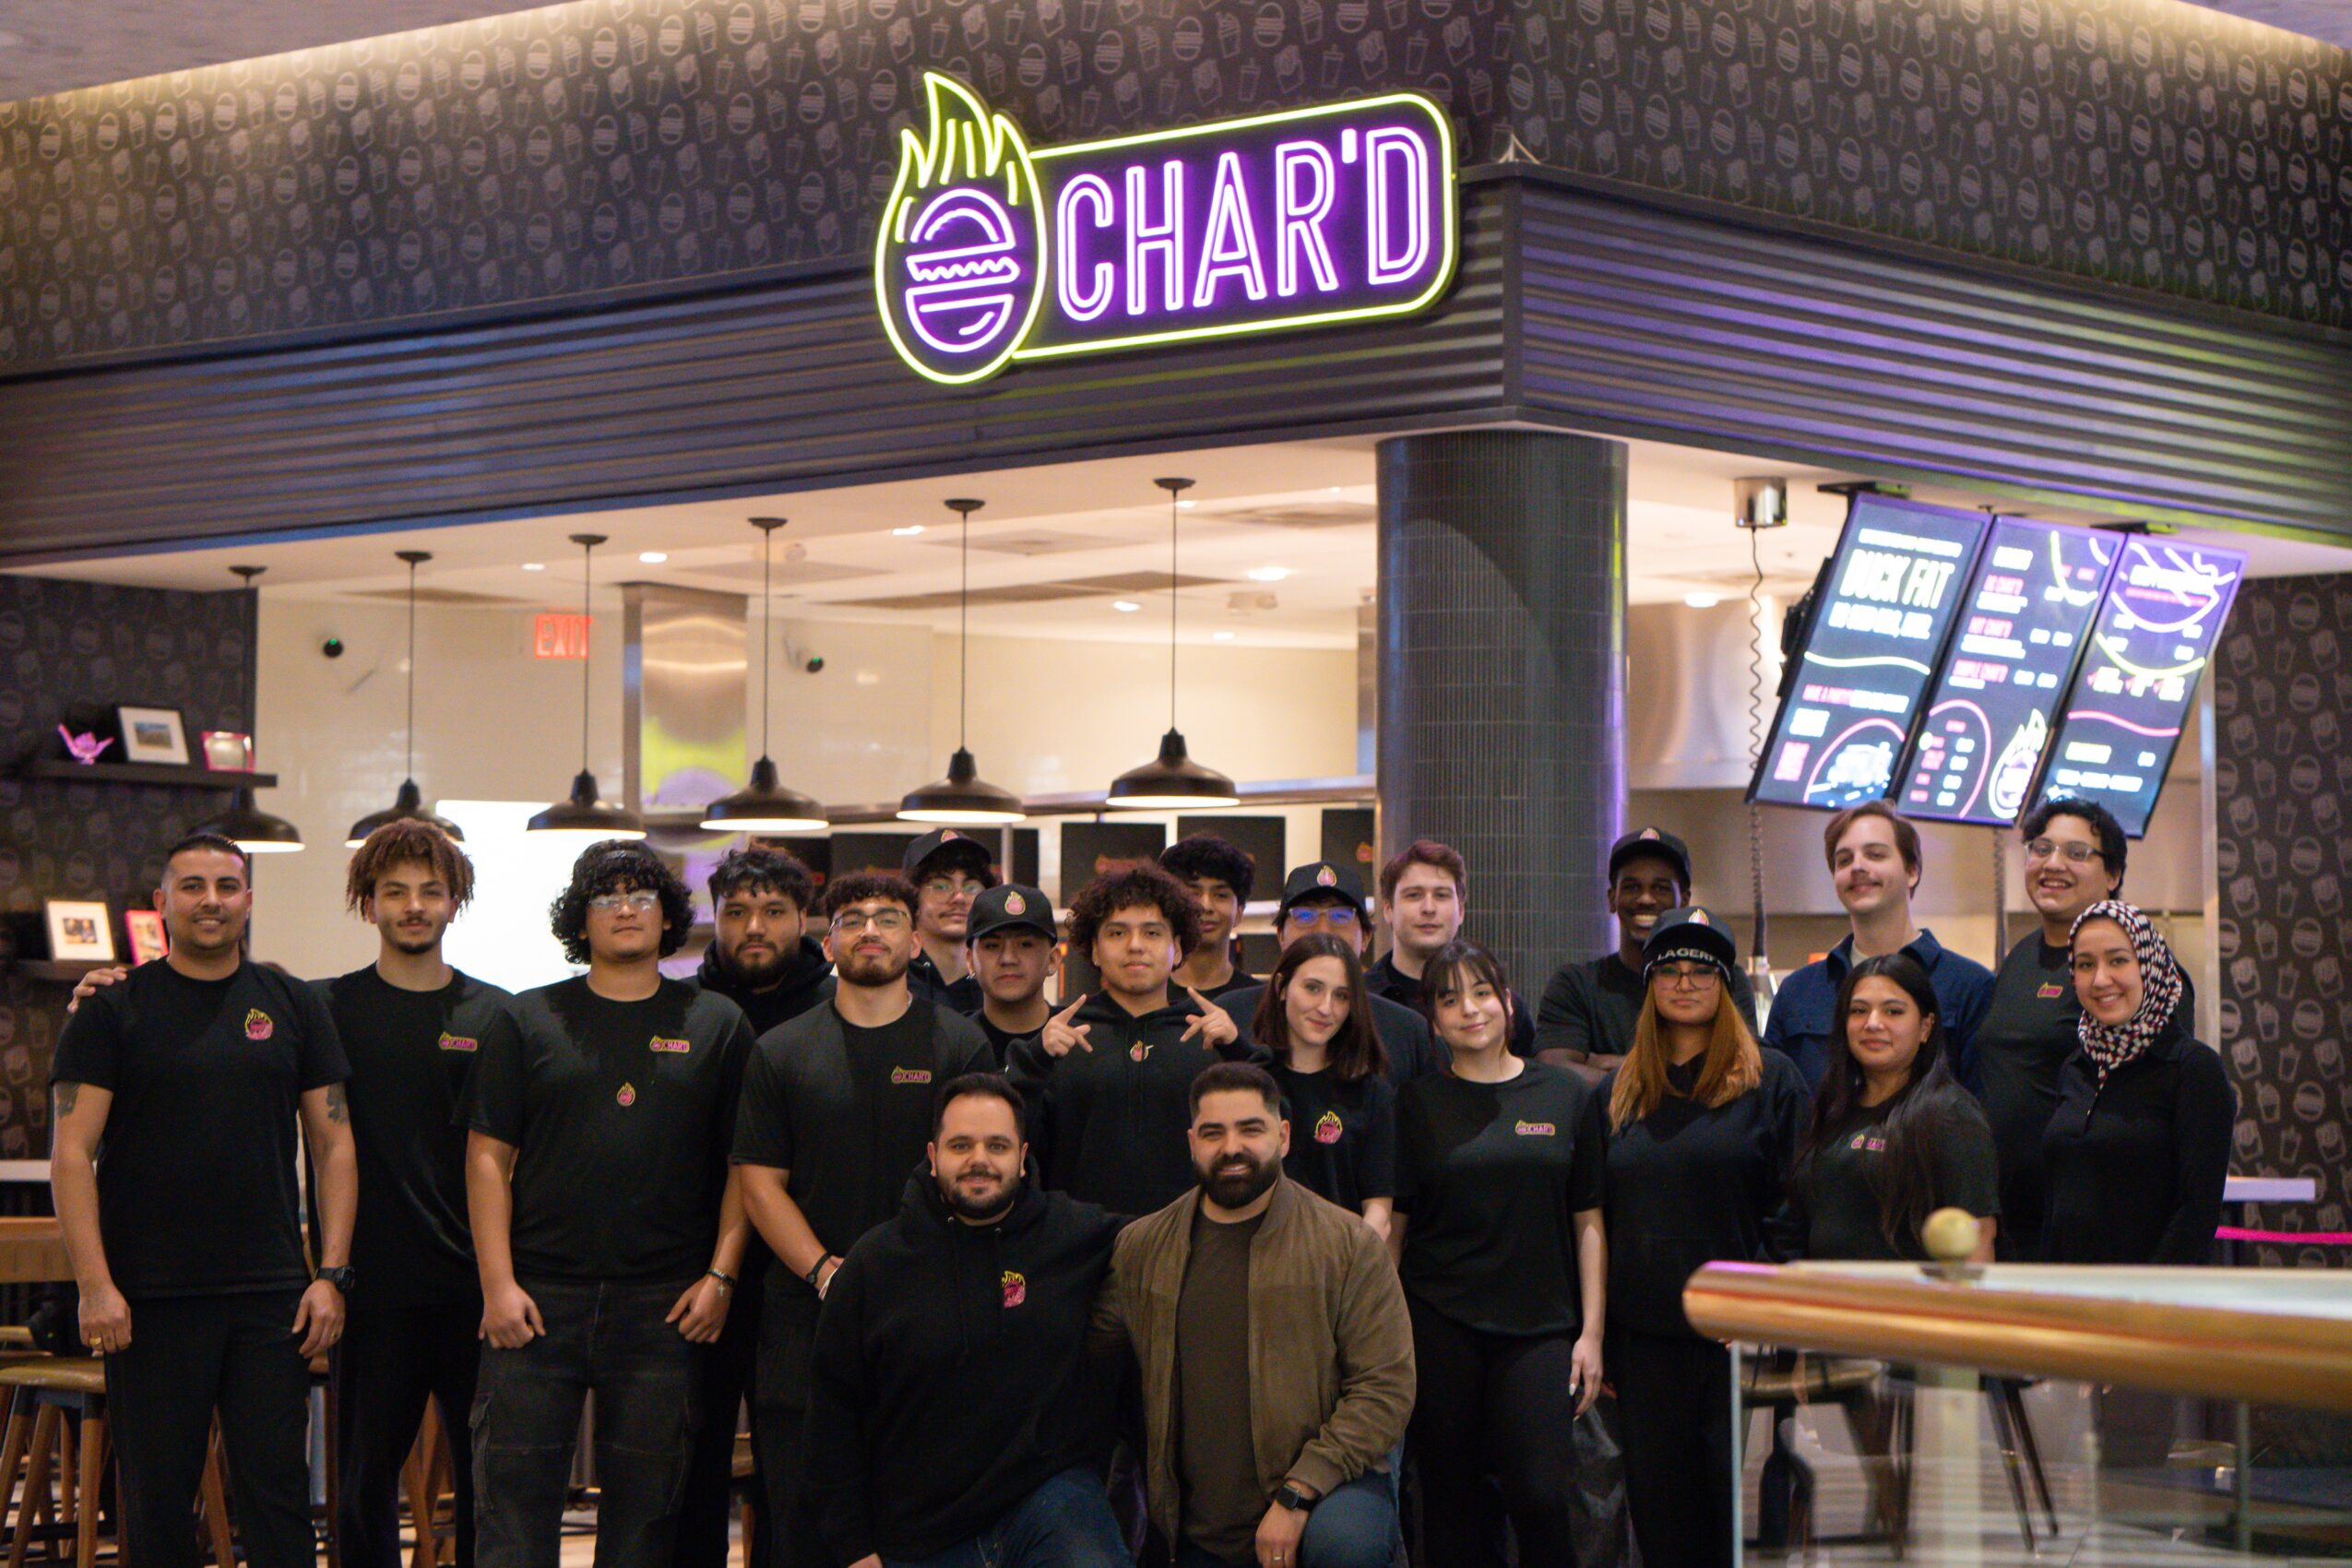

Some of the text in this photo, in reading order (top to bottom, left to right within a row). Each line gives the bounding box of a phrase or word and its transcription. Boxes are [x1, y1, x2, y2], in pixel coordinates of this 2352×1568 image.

[1057, 126, 1429, 321] CHAR'D
[1902, 559, 1955, 609] FAT
[535, 614, 594, 659] EXIT
